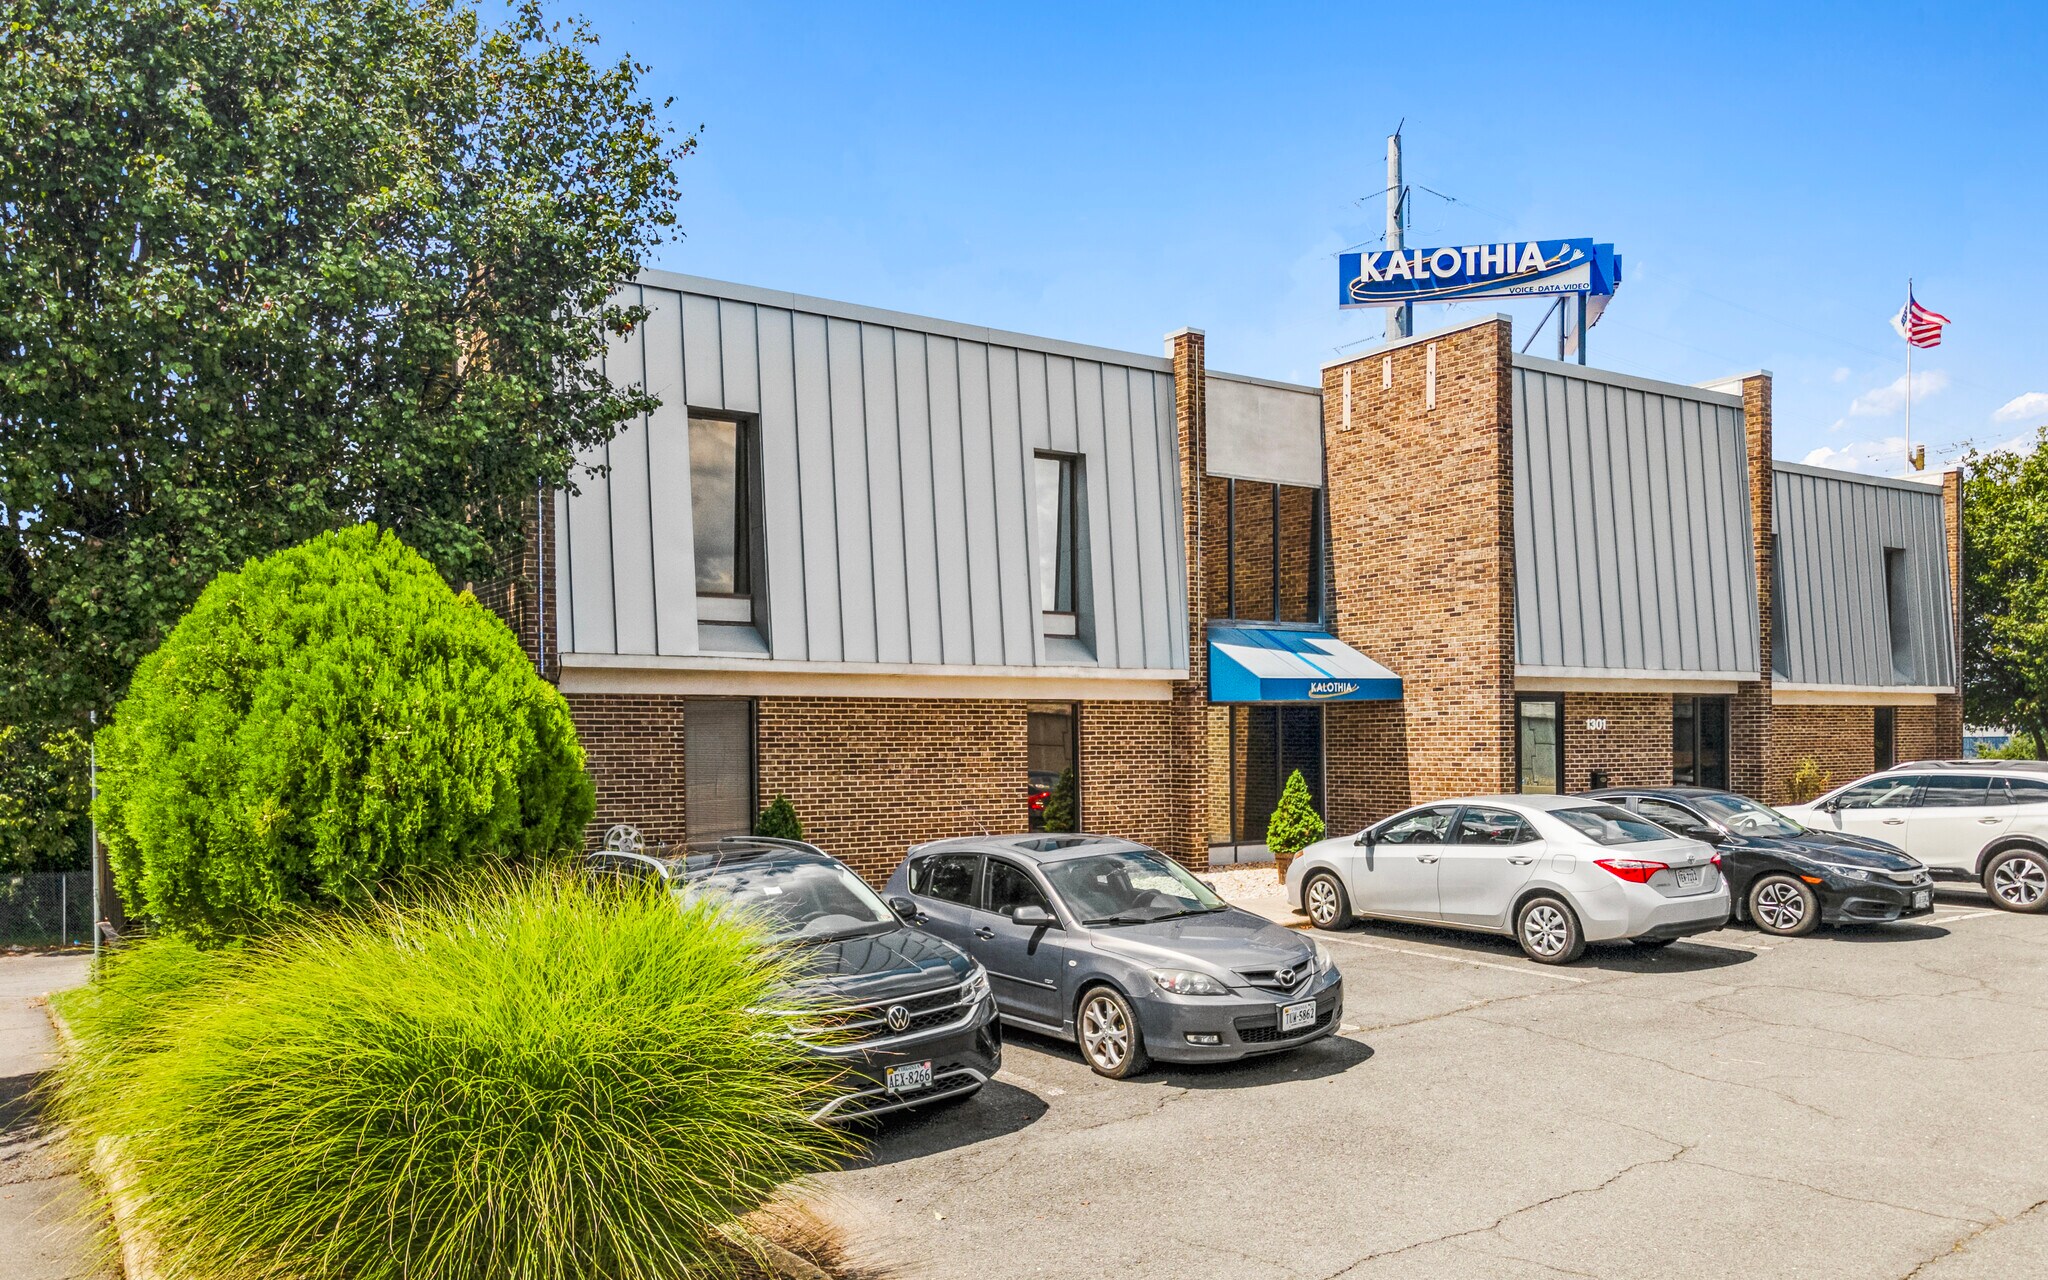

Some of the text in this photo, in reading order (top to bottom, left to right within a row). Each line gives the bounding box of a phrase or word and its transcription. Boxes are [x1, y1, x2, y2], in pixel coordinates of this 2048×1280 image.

[1361, 242, 1547, 282] KALOTHIA
[1509, 286, 1534, 294] VOICE
[1563, 282, 1590, 290] VIDEO
[1310, 682, 1352, 693] KALOTHIA
[1586, 718, 1606, 730] 1301
[889, 1069, 930, 1088] AEX-8266
